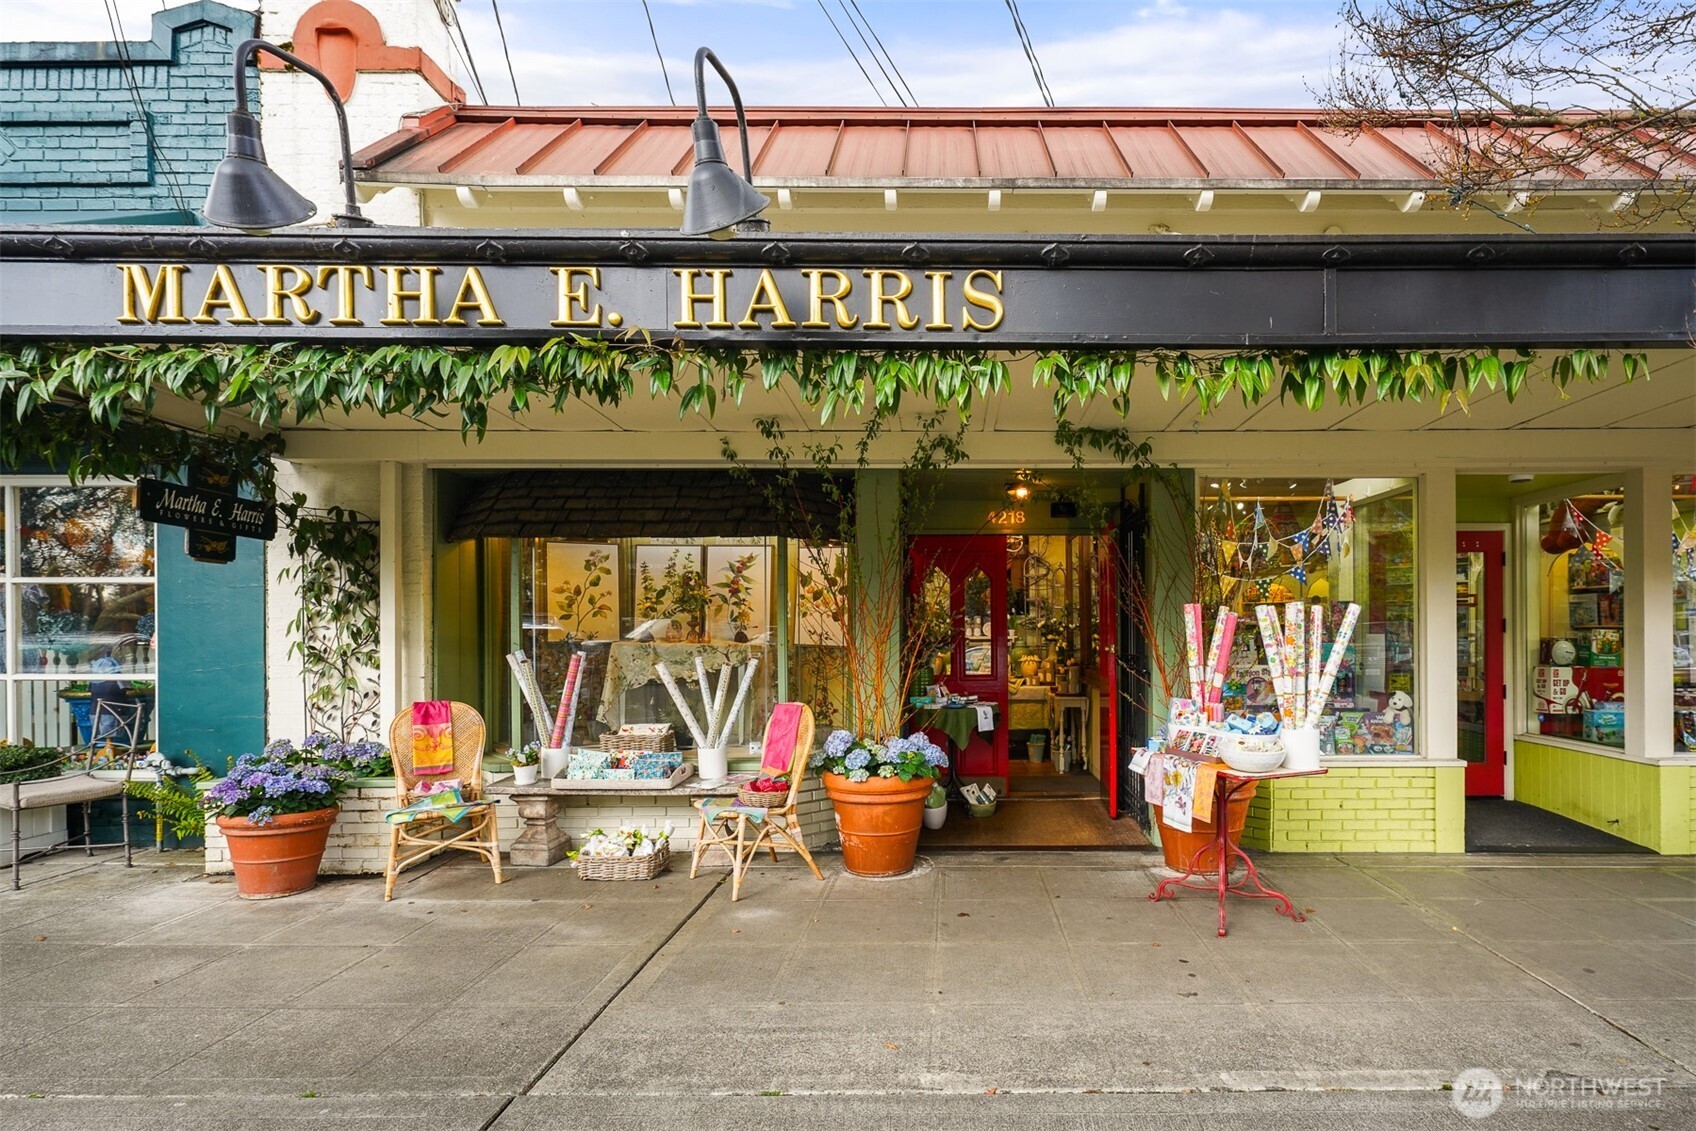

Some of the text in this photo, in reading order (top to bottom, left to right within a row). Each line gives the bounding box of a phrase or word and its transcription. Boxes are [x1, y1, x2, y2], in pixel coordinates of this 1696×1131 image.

[116, 264, 1005, 332] MARTHA E. HARRIS
[155, 488, 265, 525] Martha E. Harris
[159, 509, 214, 525] FLOWERS
[231, 521, 262, 533] GIFTS
[987, 510, 1026, 524] 4218
